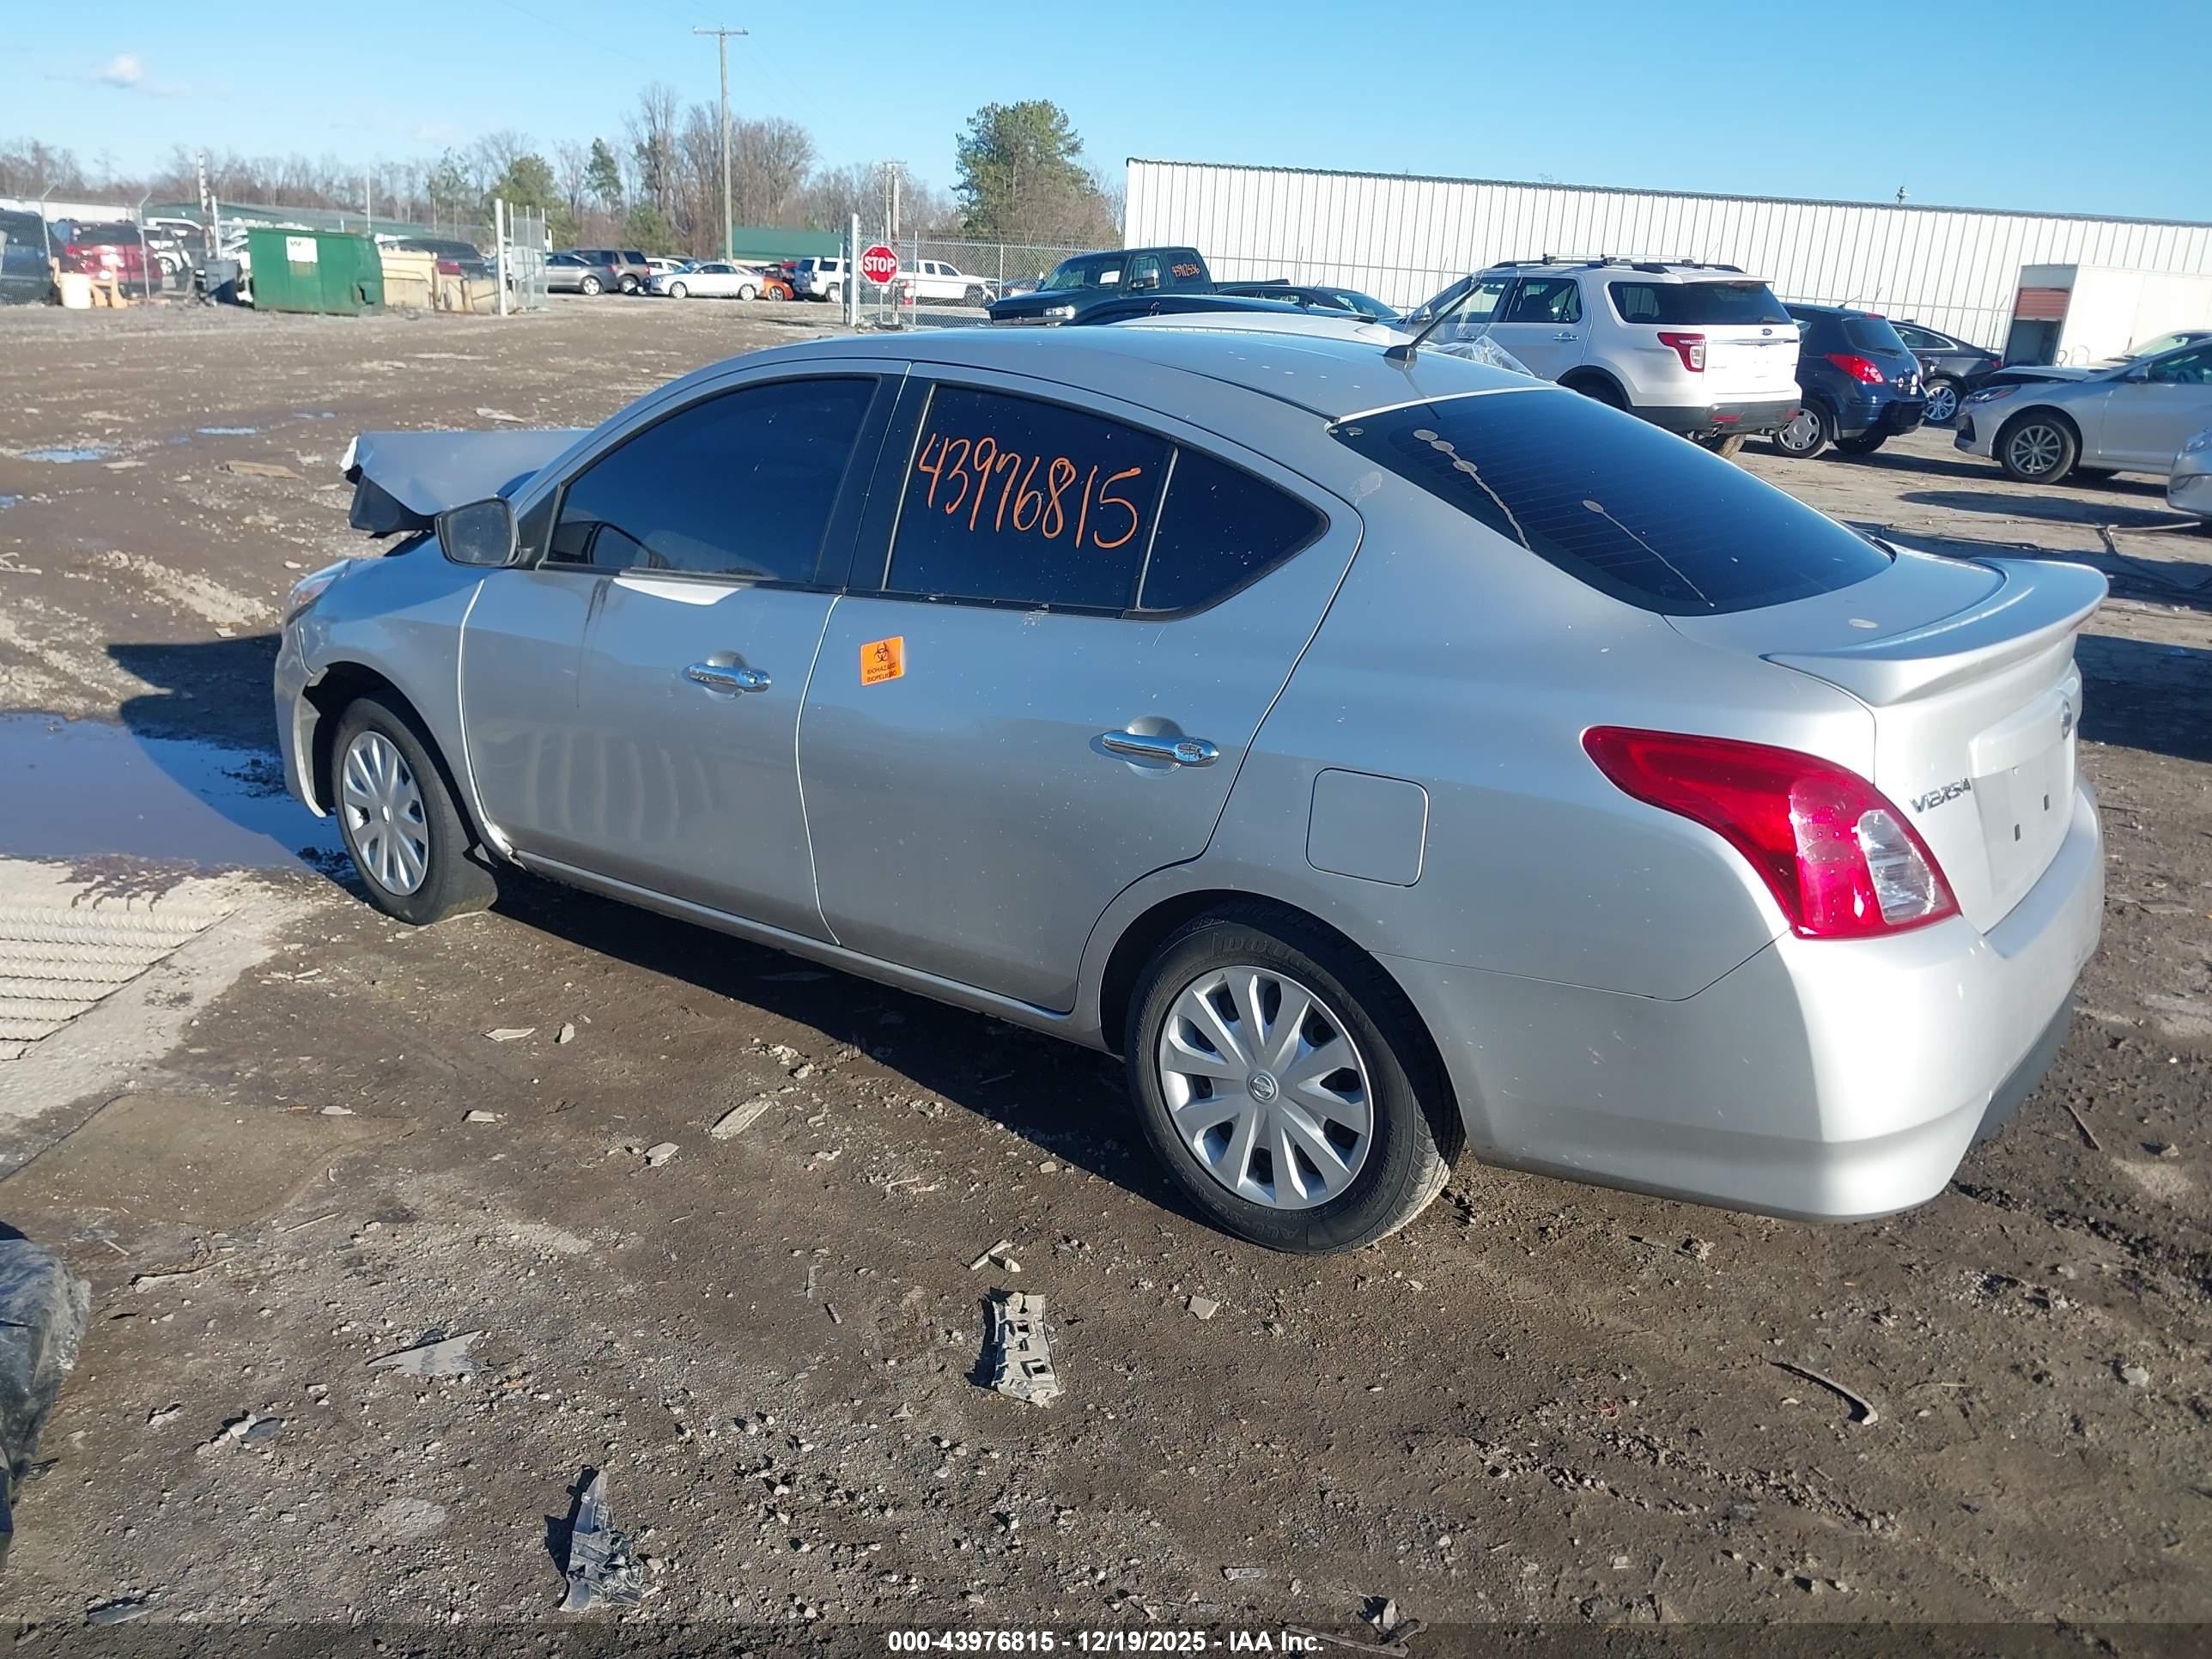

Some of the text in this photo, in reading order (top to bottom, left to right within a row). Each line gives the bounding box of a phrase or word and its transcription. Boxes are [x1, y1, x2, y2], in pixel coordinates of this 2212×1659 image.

[864, 256, 896, 272] STOP
[917, 432, 1141, 550] 43976815
[1911, 777, 1972, 812] VERSA
